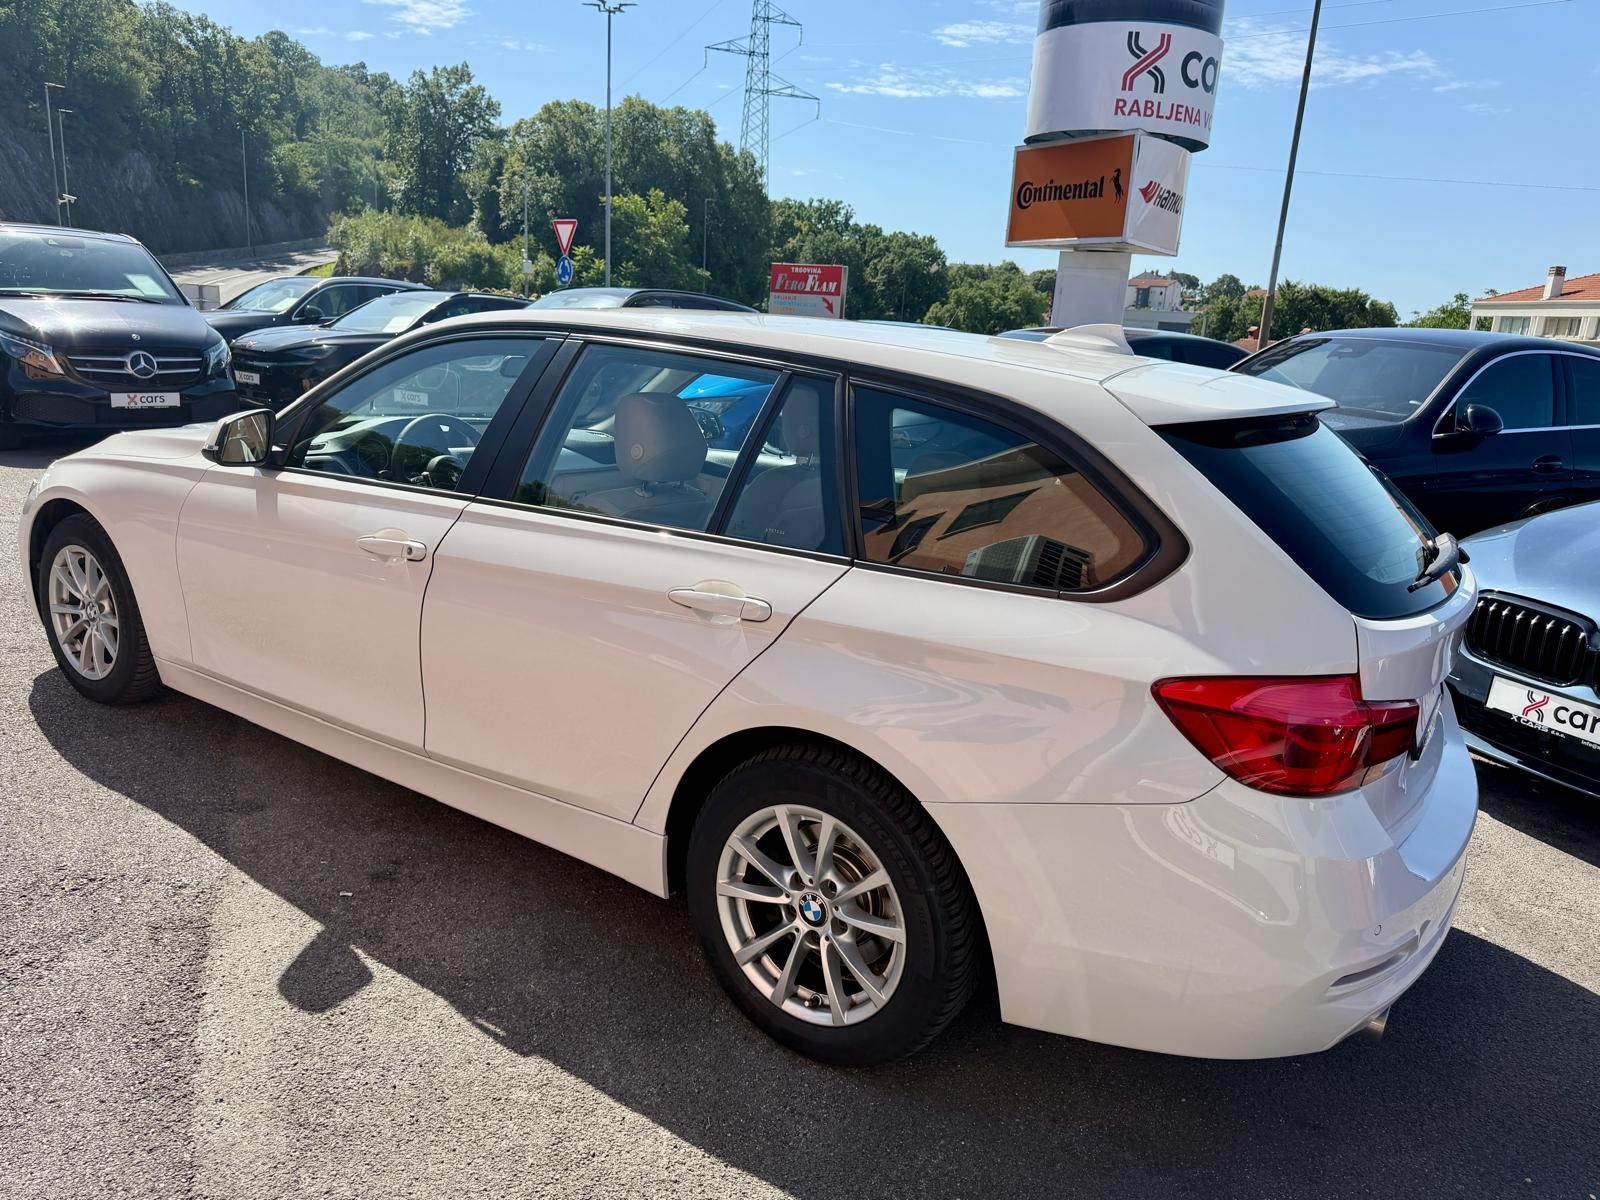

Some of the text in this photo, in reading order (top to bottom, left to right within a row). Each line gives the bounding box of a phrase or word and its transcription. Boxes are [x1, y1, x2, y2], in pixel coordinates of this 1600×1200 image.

[1113, 98, 1201, 127] RABLJENA
[1016, 176, 1104, 210] Continental
[791, 266, 821, 274] TRGOVINA
[140, 395, 165, 403] cars
[407, 393, 421, 403] cars
[1510, 714, 1519, 722] X
[1520, 717, 1549, 733] CARS
[856, 811, 919, 891] MICHELIN
[800, 894, 822, 906] BMW
